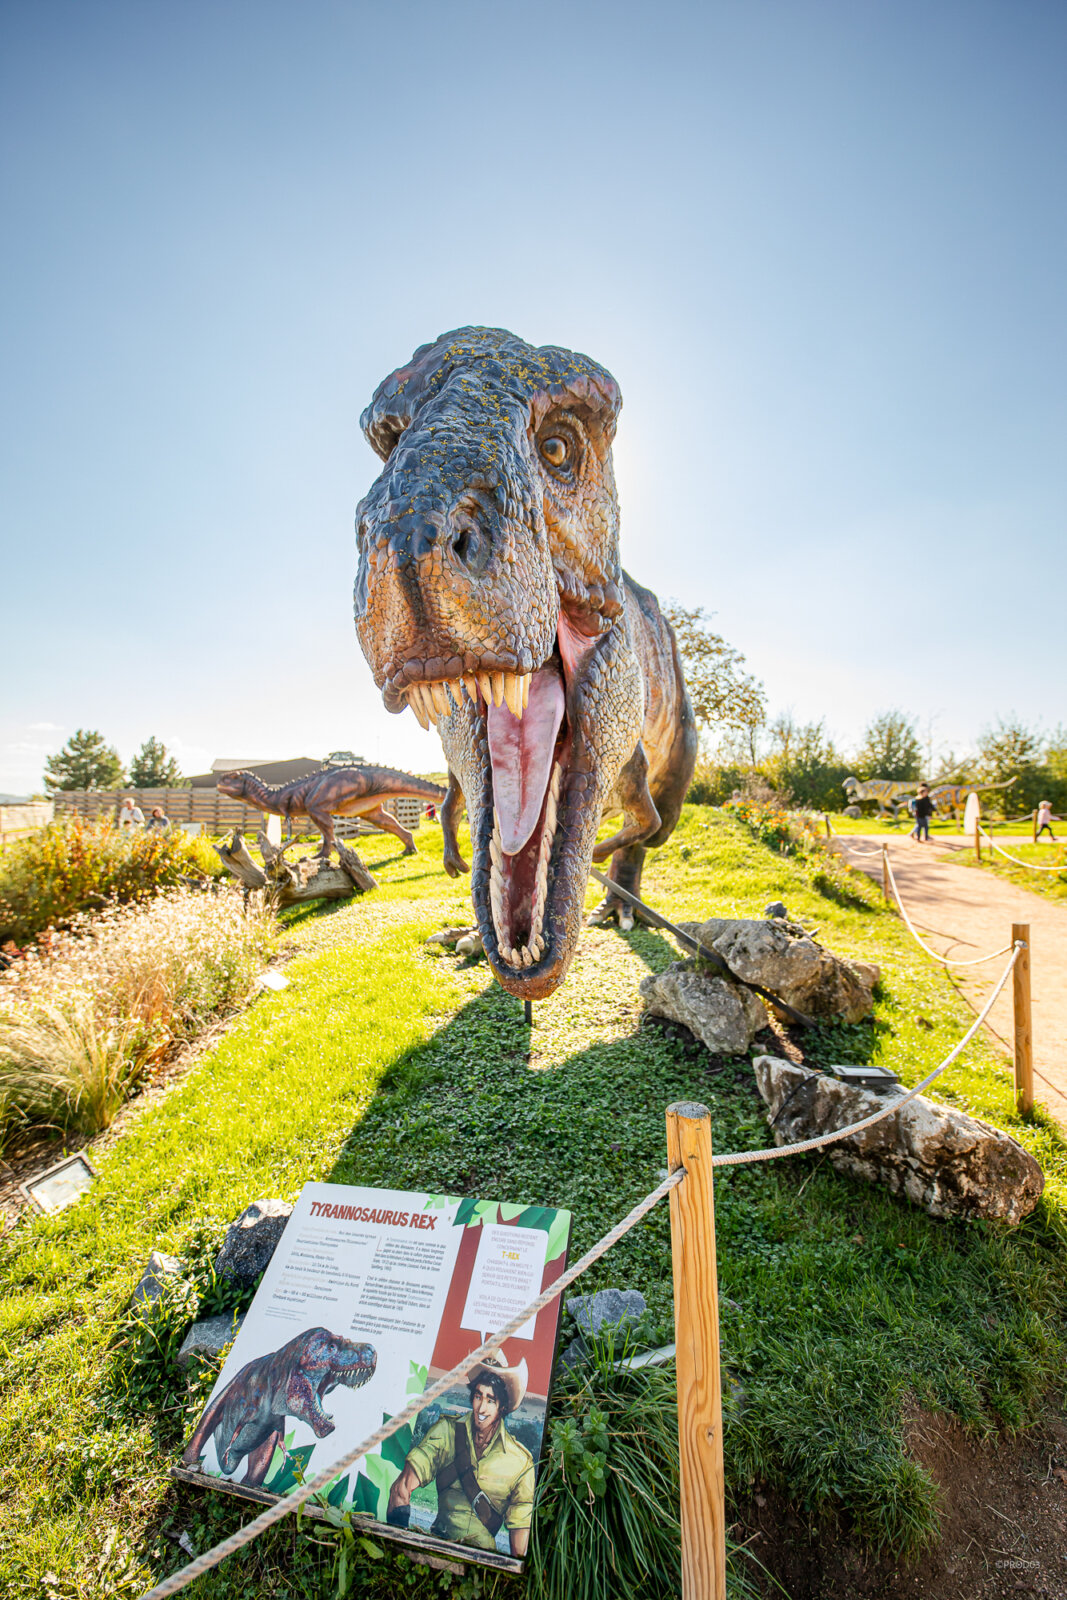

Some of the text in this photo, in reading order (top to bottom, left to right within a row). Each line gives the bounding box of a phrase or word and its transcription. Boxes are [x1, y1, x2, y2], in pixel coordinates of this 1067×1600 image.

[310, 1202, 438, 1230] TYRANNOSAURUS REX
[501, 1251, 520, 1260] T-REX
